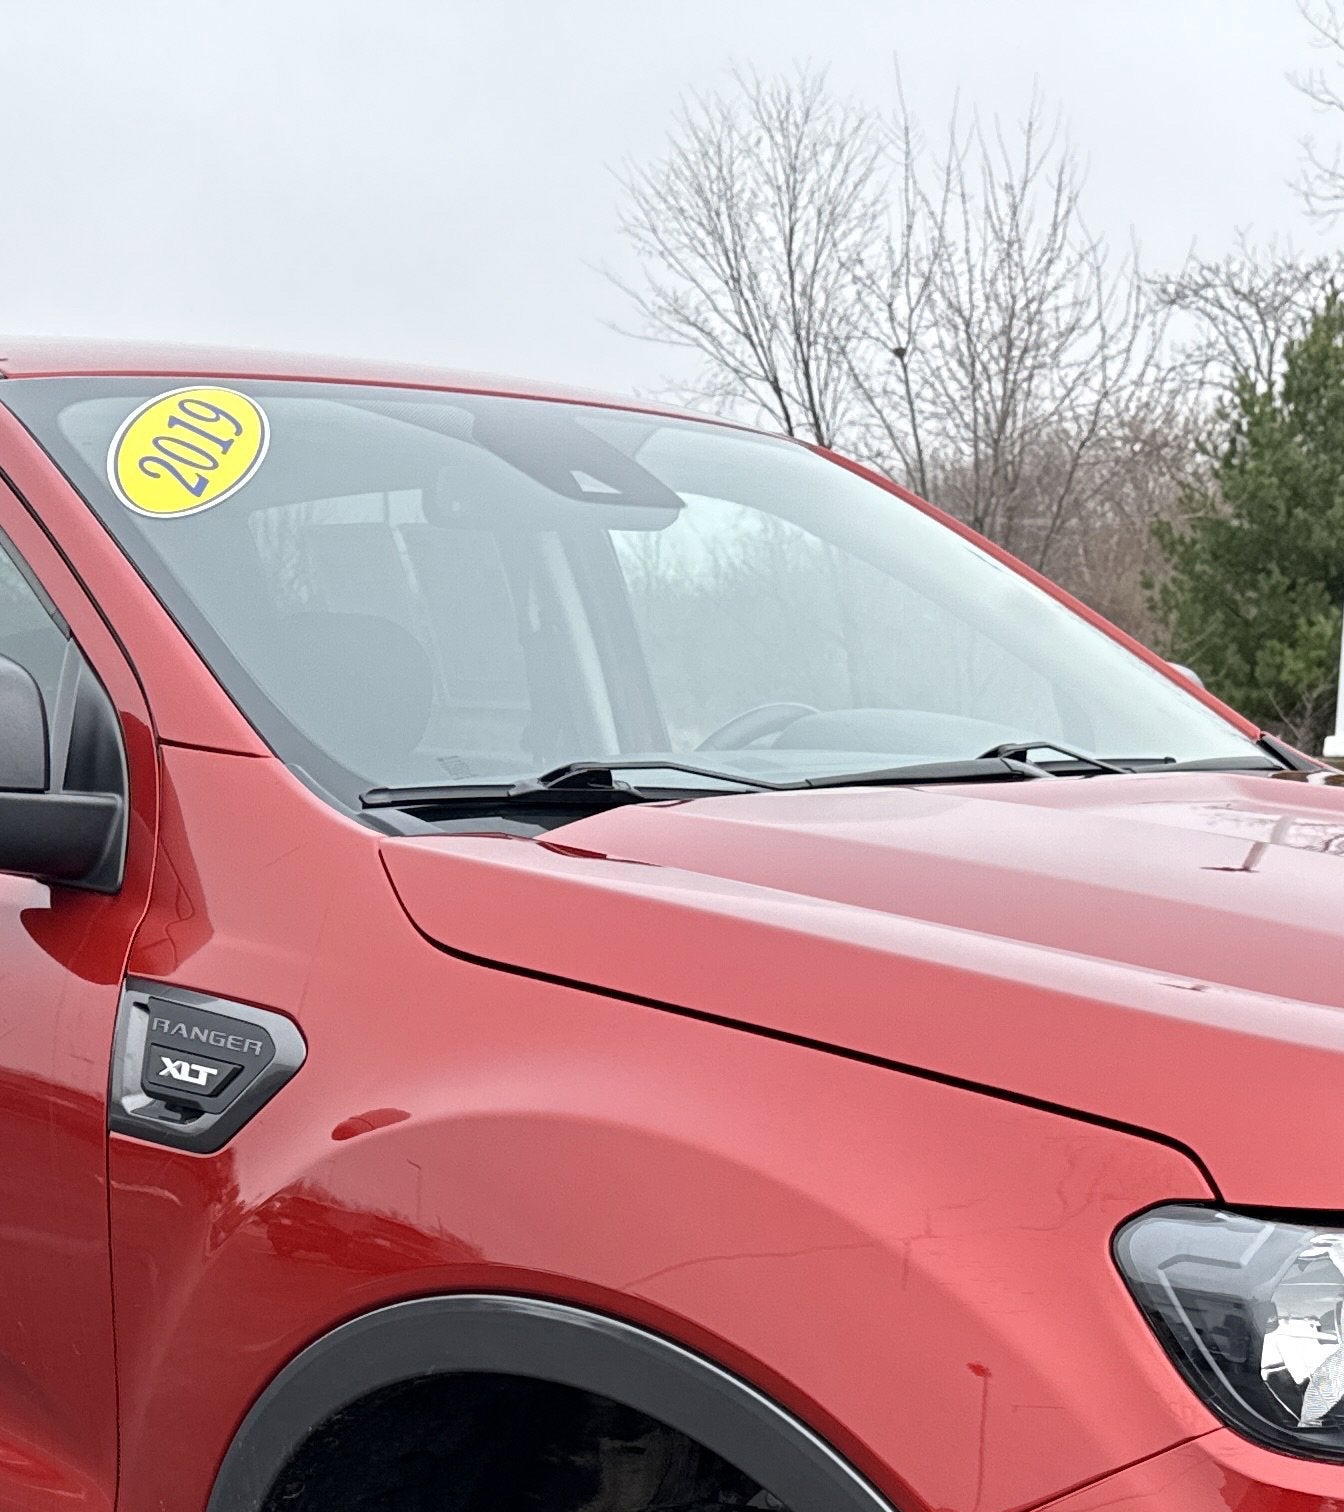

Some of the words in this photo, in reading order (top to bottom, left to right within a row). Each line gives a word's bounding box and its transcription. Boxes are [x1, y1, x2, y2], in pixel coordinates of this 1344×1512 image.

[138, 398, 243, 498] 2019
[152, 1018, 263, 1056] RANGER
[158, 1056, 218, 1086] XLT
